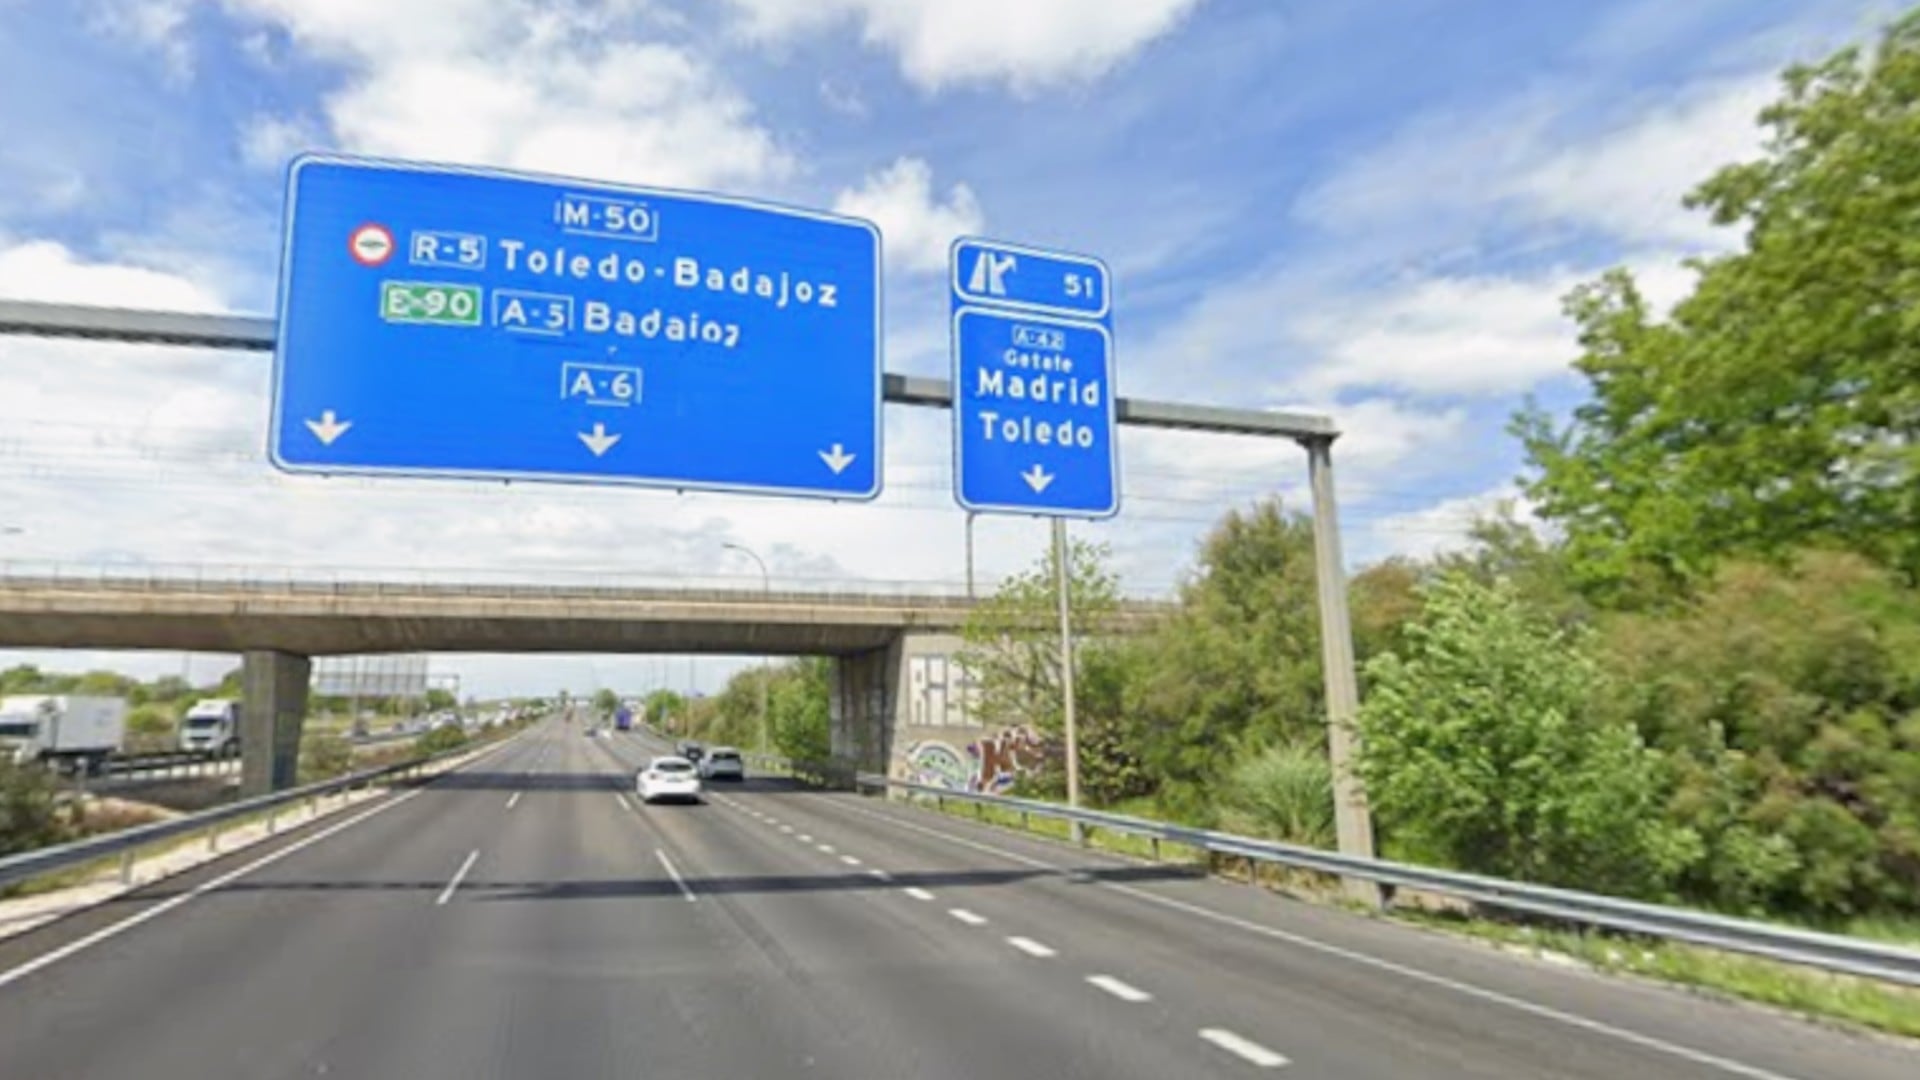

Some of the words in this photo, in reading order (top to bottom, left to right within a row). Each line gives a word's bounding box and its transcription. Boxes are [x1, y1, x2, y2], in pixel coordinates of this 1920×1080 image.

[564, 202, 650, 232] M-50
[415, 236, 480, 262] R-5
[1064, 273, 1093, 297] 51
[387, 288, 473, 316] E-90
[501, 299, 565, 328] A-5
[570, 370, 633, 398] A-6
[977, 367, 1099, 406] Madrid
[979, 412, 1093, 447] Toledo
